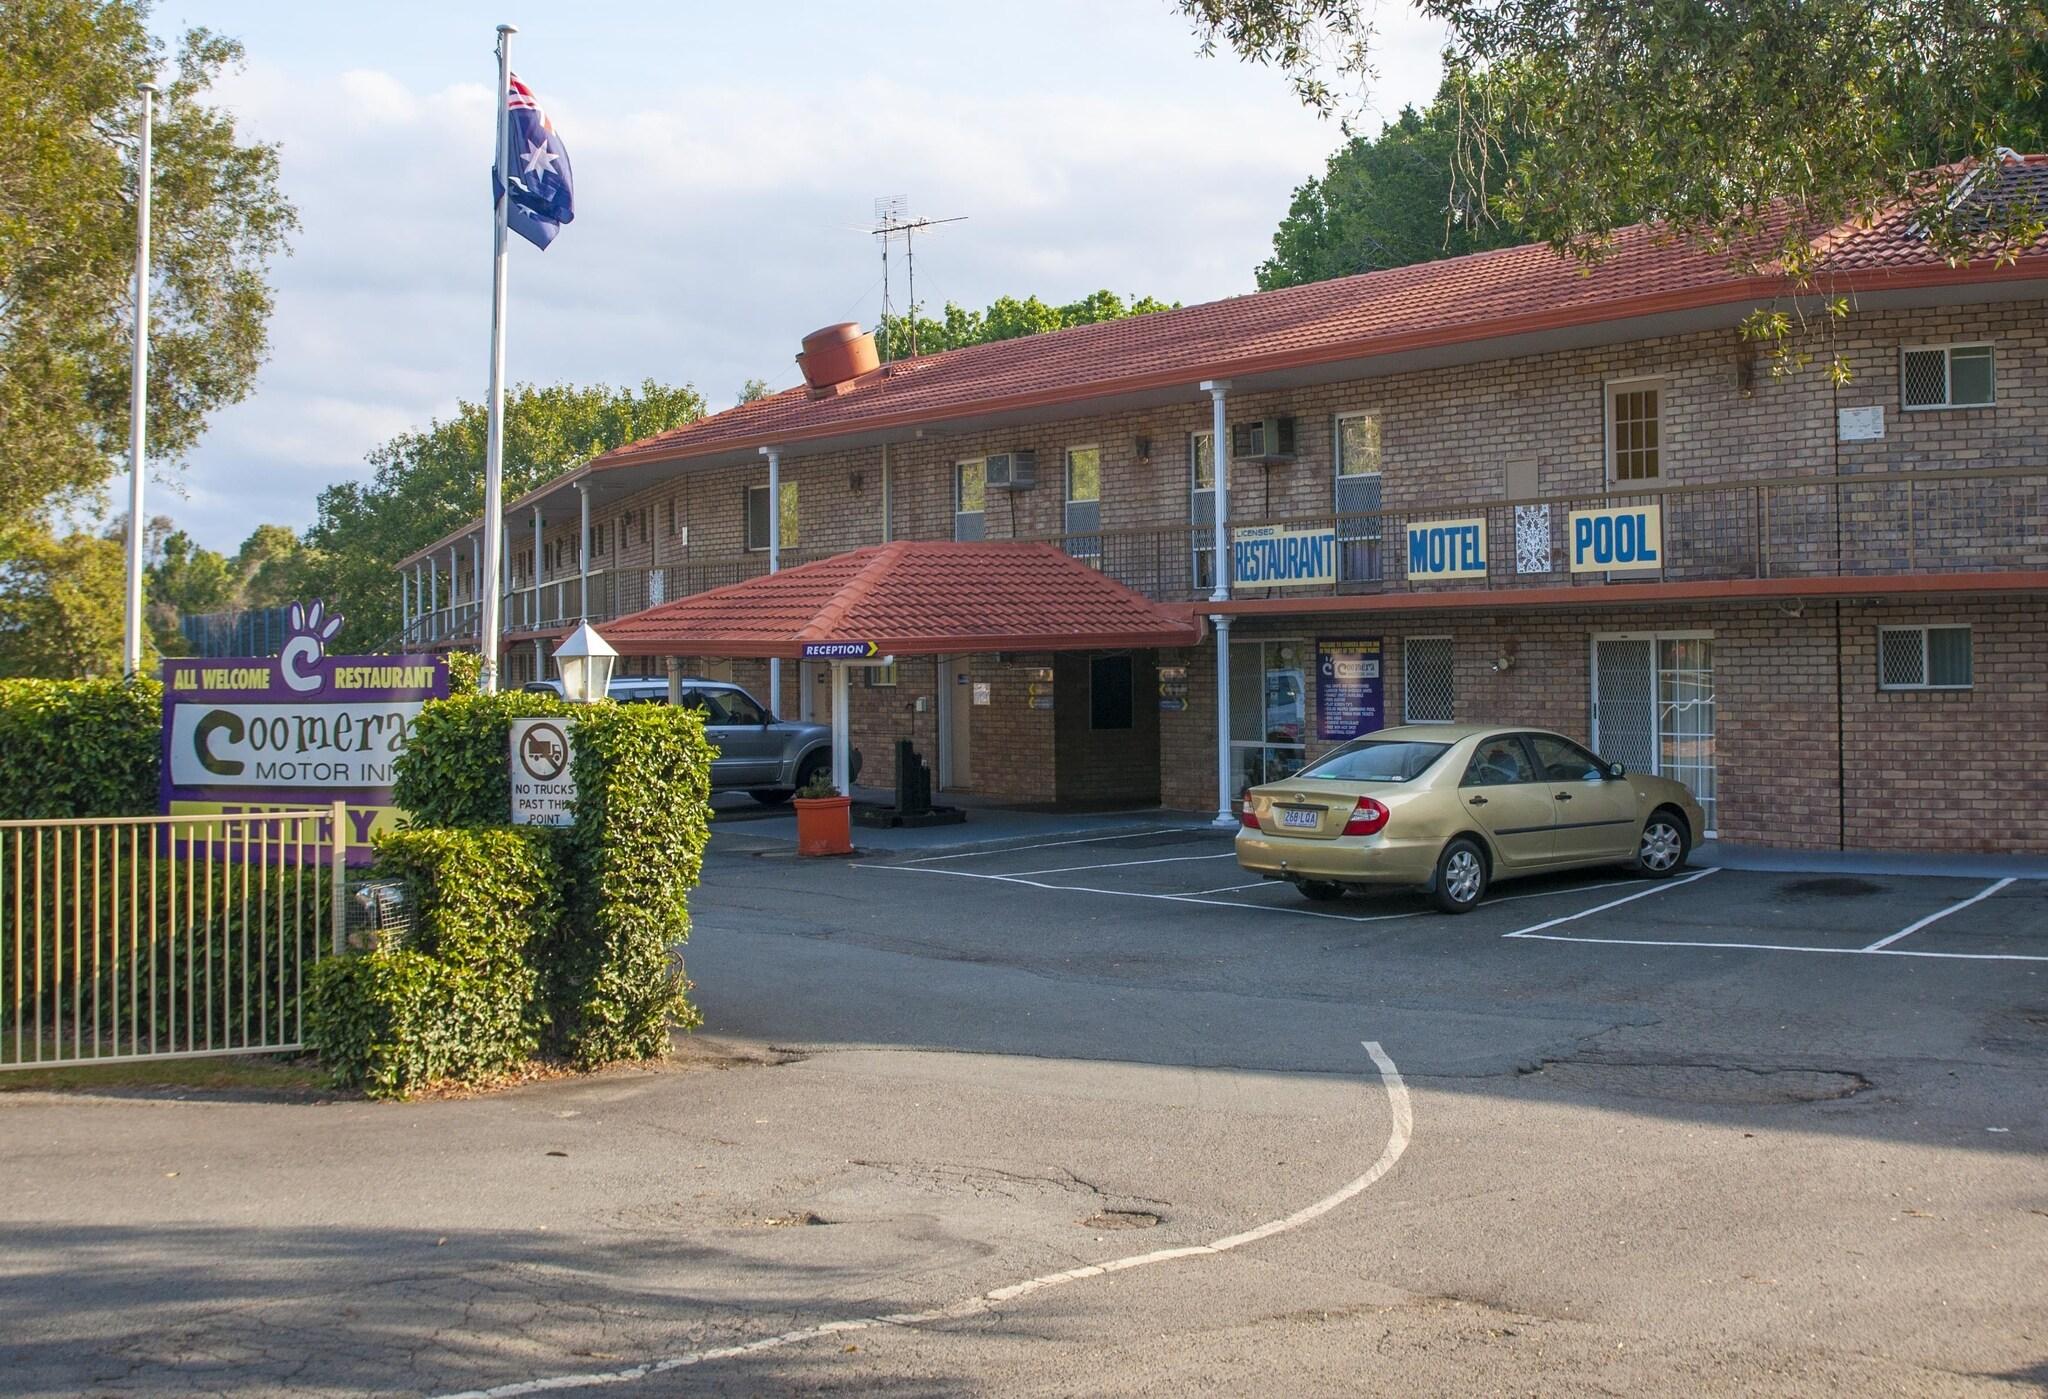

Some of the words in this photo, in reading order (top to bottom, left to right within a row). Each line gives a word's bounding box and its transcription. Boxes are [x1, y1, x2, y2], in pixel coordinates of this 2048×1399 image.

[1236, 527, 1275, 538] LICENSED
[1576, 514, 1657, 565] POOL
[1235, 535, 1335, 582] RESTAURANT
[1409, 525, 1486, 573] MOTEL
[806, 645, 864, 656] RECEPTION
[174, 669, 199, 690] ALL
[202, 668, 271, 690] WELCOME
[335, 666, 436, 689] RESTAURANT
[194, 709, 410, 776] Coomera
[256, 762, 349, 781] MOTOR
[515, 784, 530, 794] NO
[534, 784, 575, 795] TRUCKS
[519, 799, 544, 809] PAST
[530, 814, 561, 824] POINT
